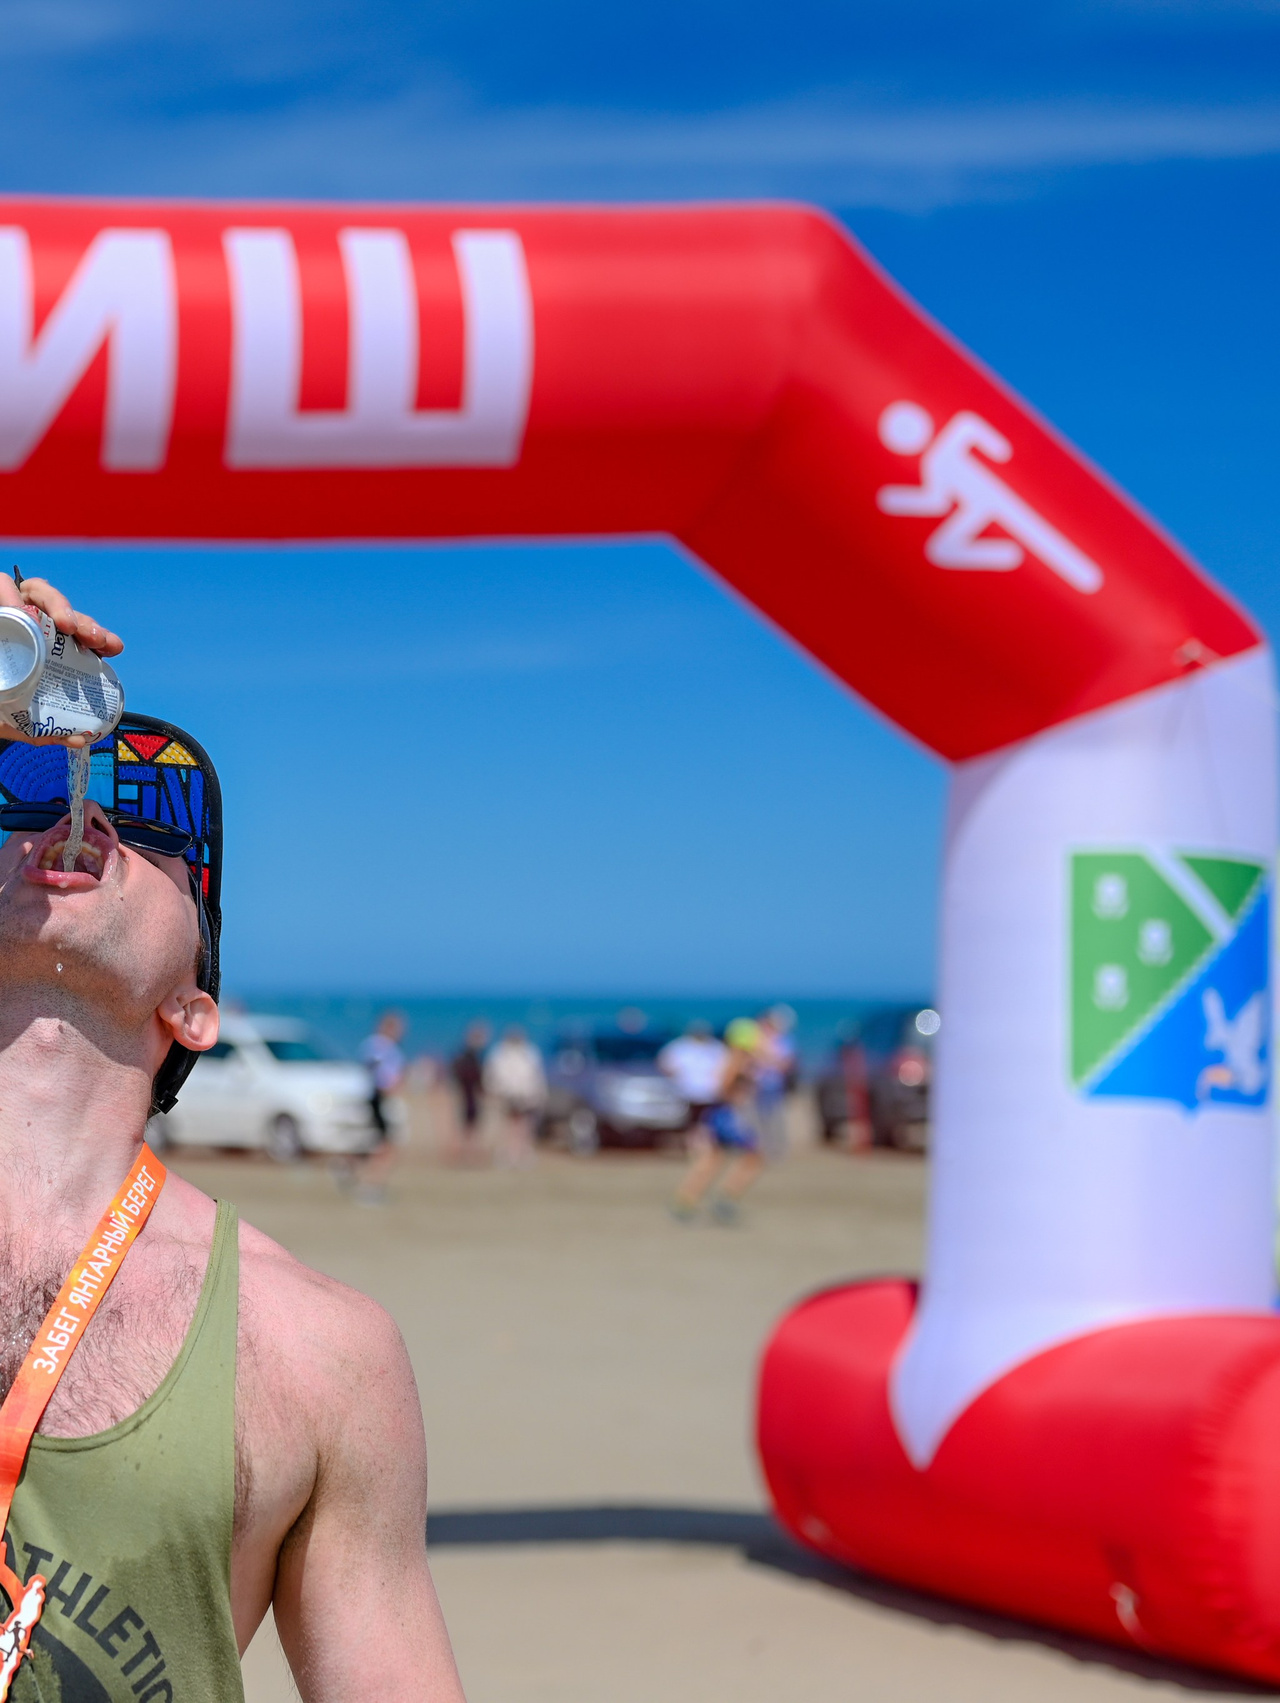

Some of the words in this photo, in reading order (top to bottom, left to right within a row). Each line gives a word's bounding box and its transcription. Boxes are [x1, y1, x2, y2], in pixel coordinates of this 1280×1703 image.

[33, 1307, 81, 1374] ЗАБЕГ
[68, 1211, 135, 1309] ЯНТАРНЫЙ
[121, 1166, 156, 1217] БЕРЕГ
